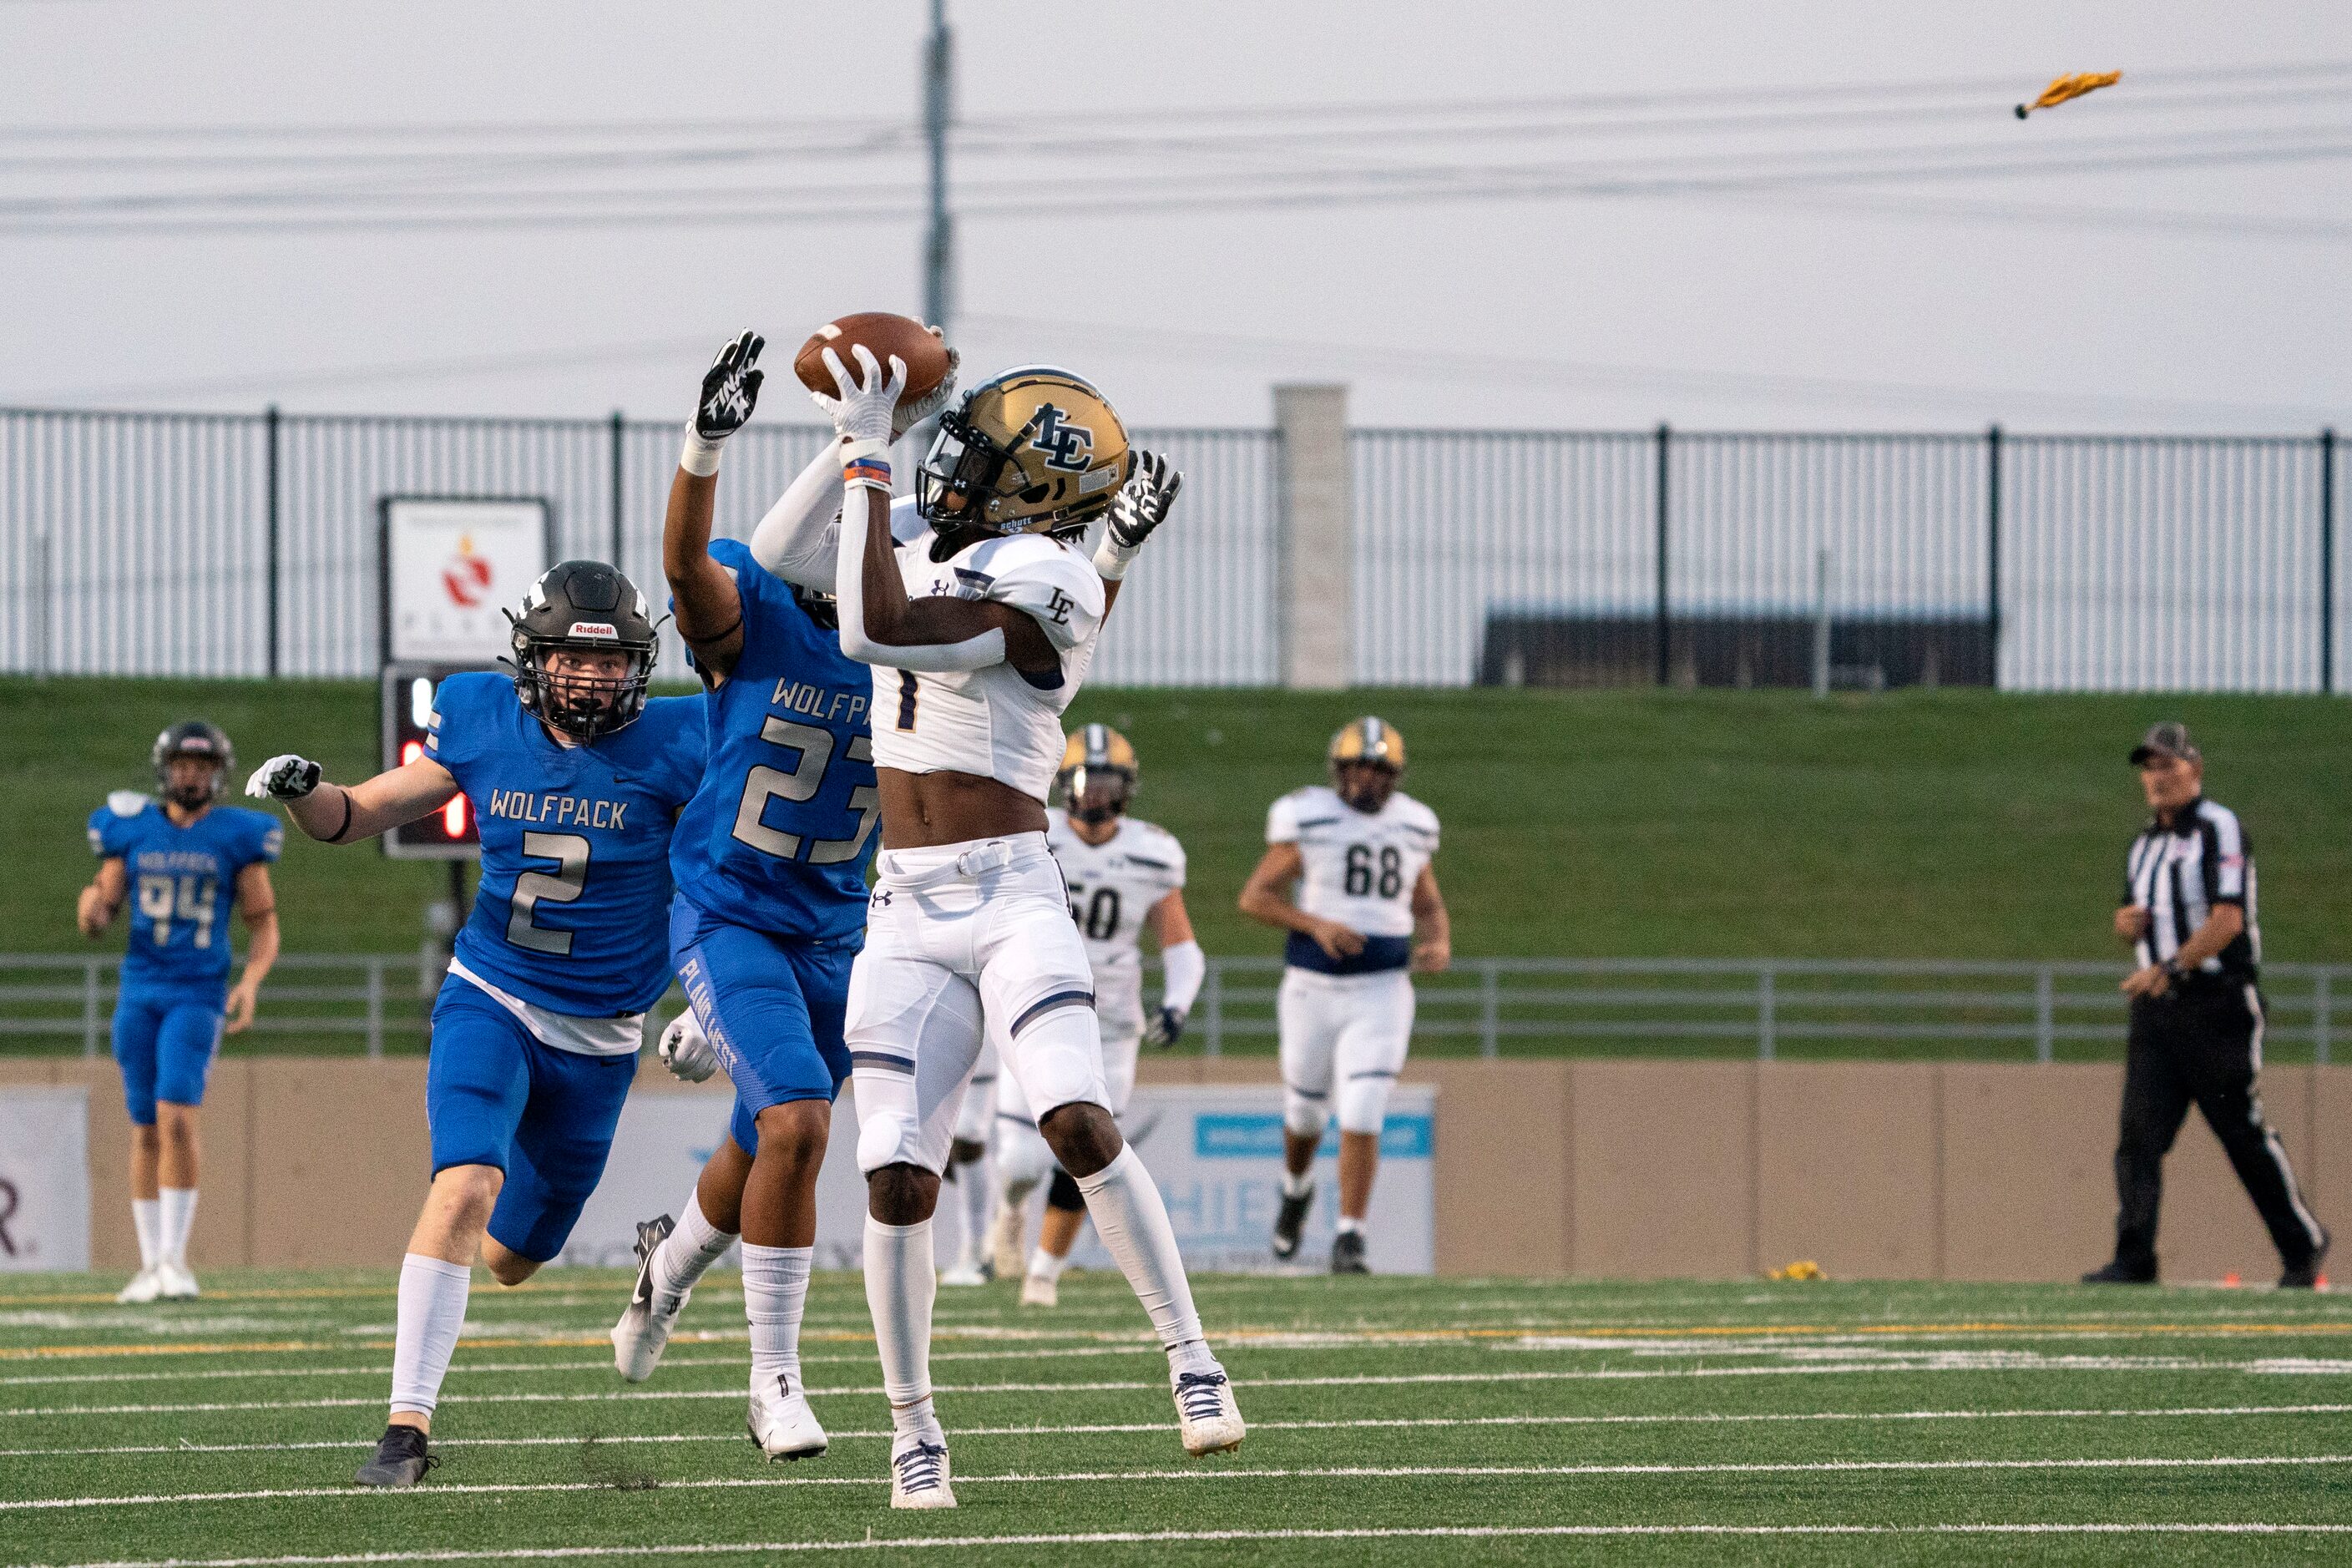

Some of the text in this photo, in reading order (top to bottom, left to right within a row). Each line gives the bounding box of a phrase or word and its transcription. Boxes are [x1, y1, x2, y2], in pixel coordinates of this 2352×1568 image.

[1000, 517, 1032, 530] schutt
[575, 625, 612, 635] Riddell
[1046, 586, 1075, 626] LE
[894, 667, 921, 735] 1
[489, 788, 628, 831] WOLFPACK
[731, 713, 882, 865] 23
[506, 830, 592, 957] 2
[1344, 843, 1402, 900] 68
[137, 874, 217, 949] 94
